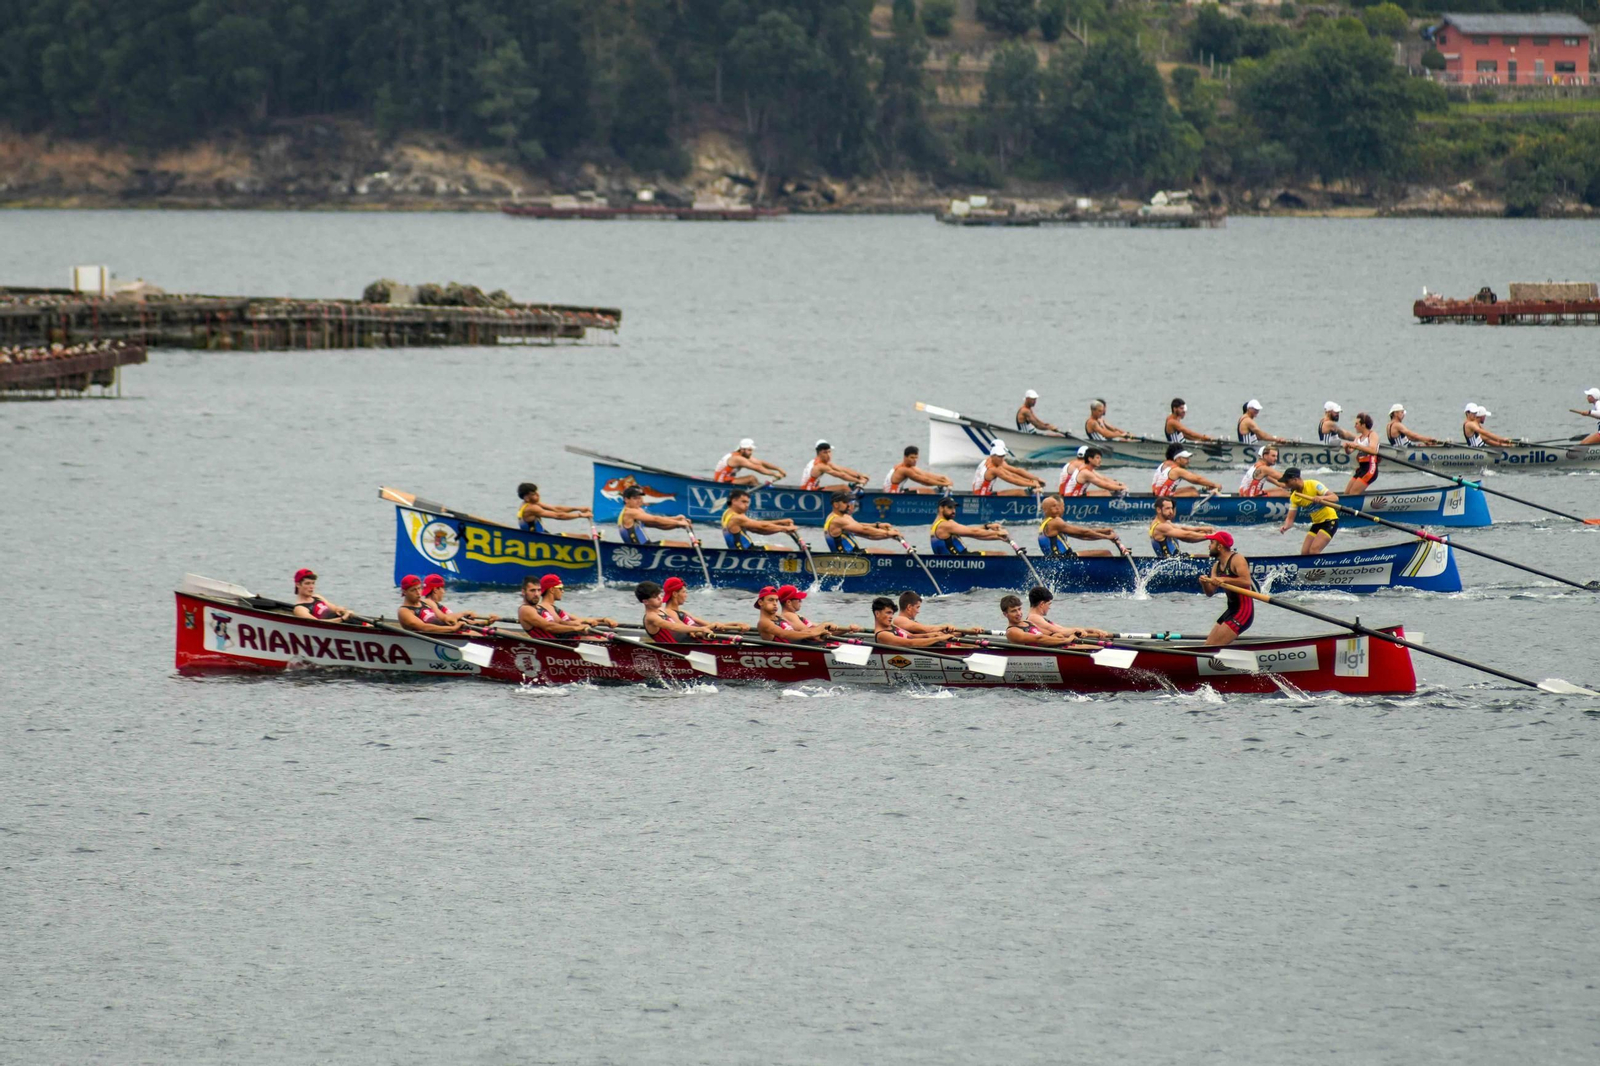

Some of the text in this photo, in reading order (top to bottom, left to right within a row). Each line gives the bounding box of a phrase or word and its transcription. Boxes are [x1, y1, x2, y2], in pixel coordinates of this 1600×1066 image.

[1243, 446, 1350, 467] Slgado
[1430, 453, 1485, 461] Concello de
[689, 486, 823, 513] WFCO
[1390, 495, 1436, 504] Xacobeo
[465, 526, 597, 562] Rianxo
[644, 550, 769, 571] fesba
[1329, 566, 1384, 576] Xacobeo
[1327, 576, 1354, 584] 2027
[236, 623, 414, 666] RIANXEIRA
[1258, 651, 1307, 662] cobeo
[428, 662, 474, 671] we sea
[548, 666, 621, 679] DA CORUÑA
